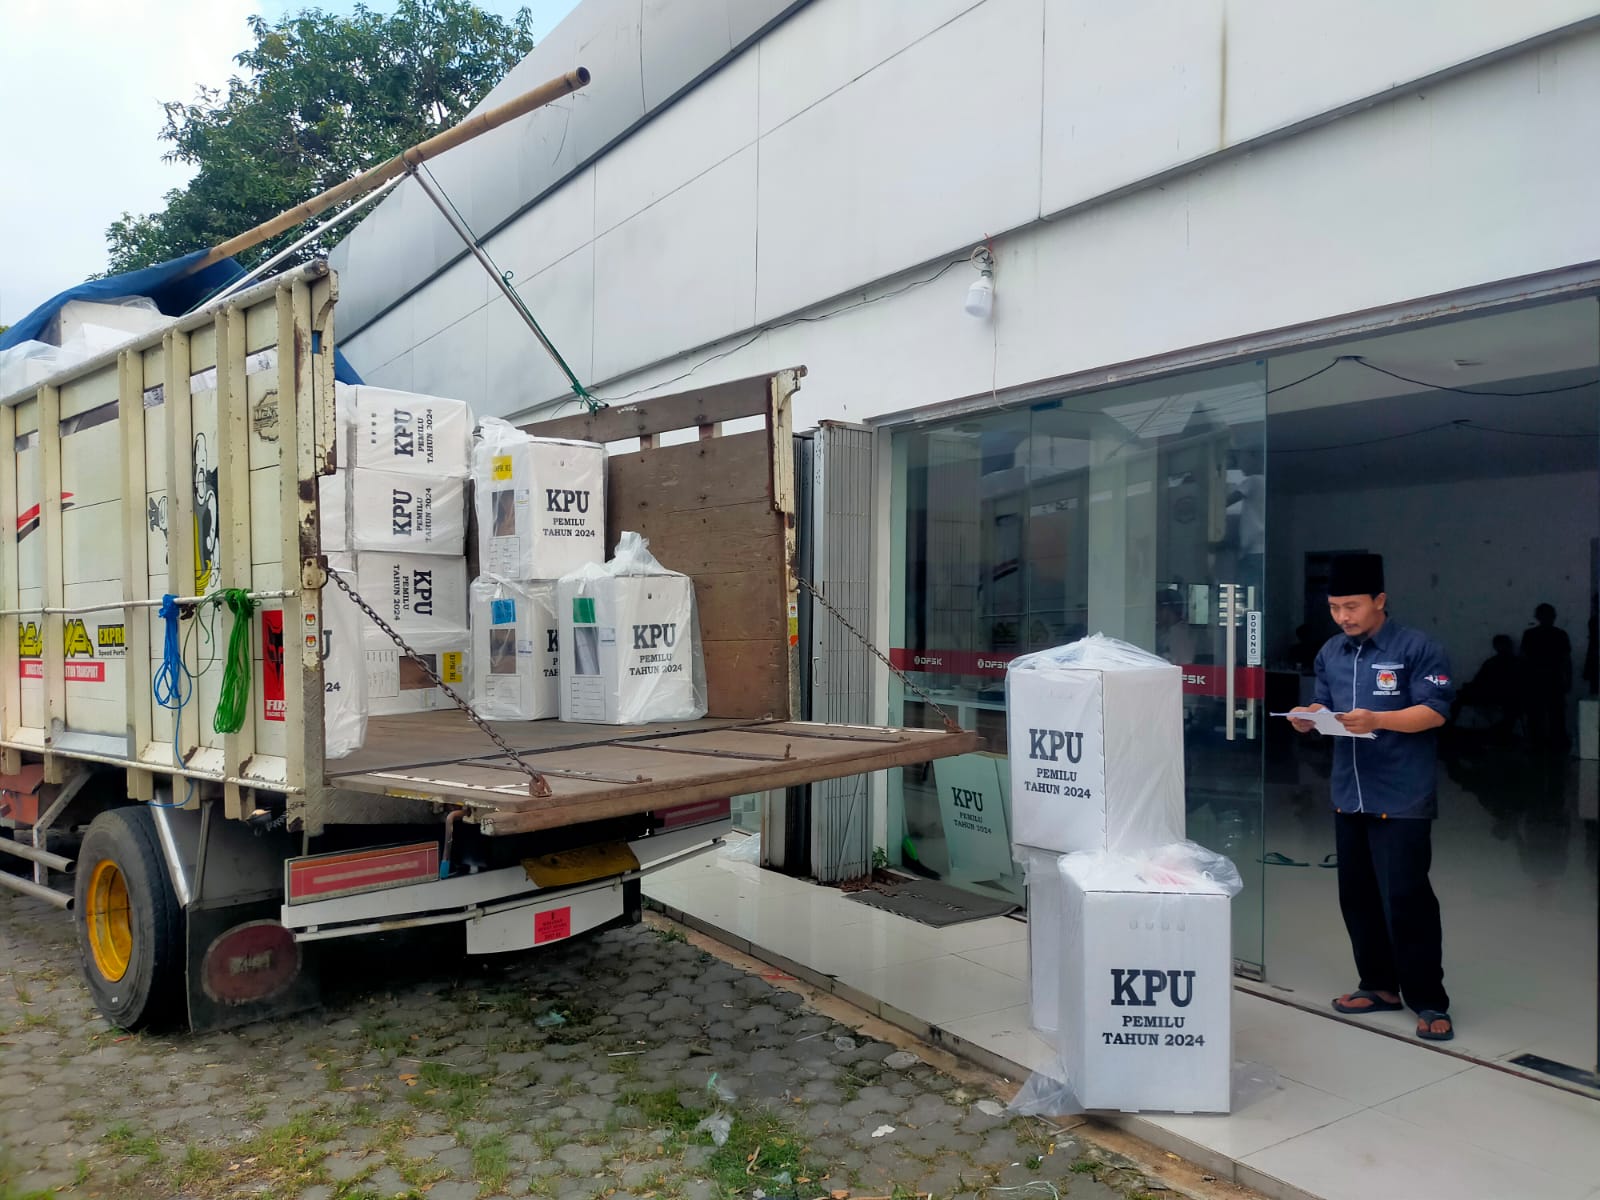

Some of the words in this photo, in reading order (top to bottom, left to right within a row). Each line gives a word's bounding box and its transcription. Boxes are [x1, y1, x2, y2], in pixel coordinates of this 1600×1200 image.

[394, 408, 413, 457] KPU
[546, 489, 590, 513] KPU
[393, 489, 412, 536] KPU
[553, 518, 585, 526] PEMILU
[543, 529, 572, 537] TAHUN
[575, 529, 595, 537] 2024
[414, 570, 432, 616] KPU
[633, 623, 676, 649] KPU
[640, 653, 672, 663] PEMILU
[920, 657, 942, 666] DFSK
[629, 666, 659, 676] TAHUN
[662, 664, 682, 673] 2024
[1181, 674, 1206, 685] FSK
[326, 682, 340, 692] 24
[1029, 728, 1083, 764] KPU
[1036, 768, 1077, 782] PEMILU
[1024, 781, 1060, 795] TAHUN
[1063, 786, 1091, 799] 2024
[952, 787, 983, 812] KPU
[959, 812, 983, 824] PEMILU
[954, 819, 975, 831] TAHUN
[976, 825, 992, 834] 2024
[1110, 969, 1196, 1007] KPU
[1122, 1015, 1186, 1028] PEMILU
[1102, 1032, 1159, 1045] TAHUN
[1165, 1034, 1205, 1046] 2024
